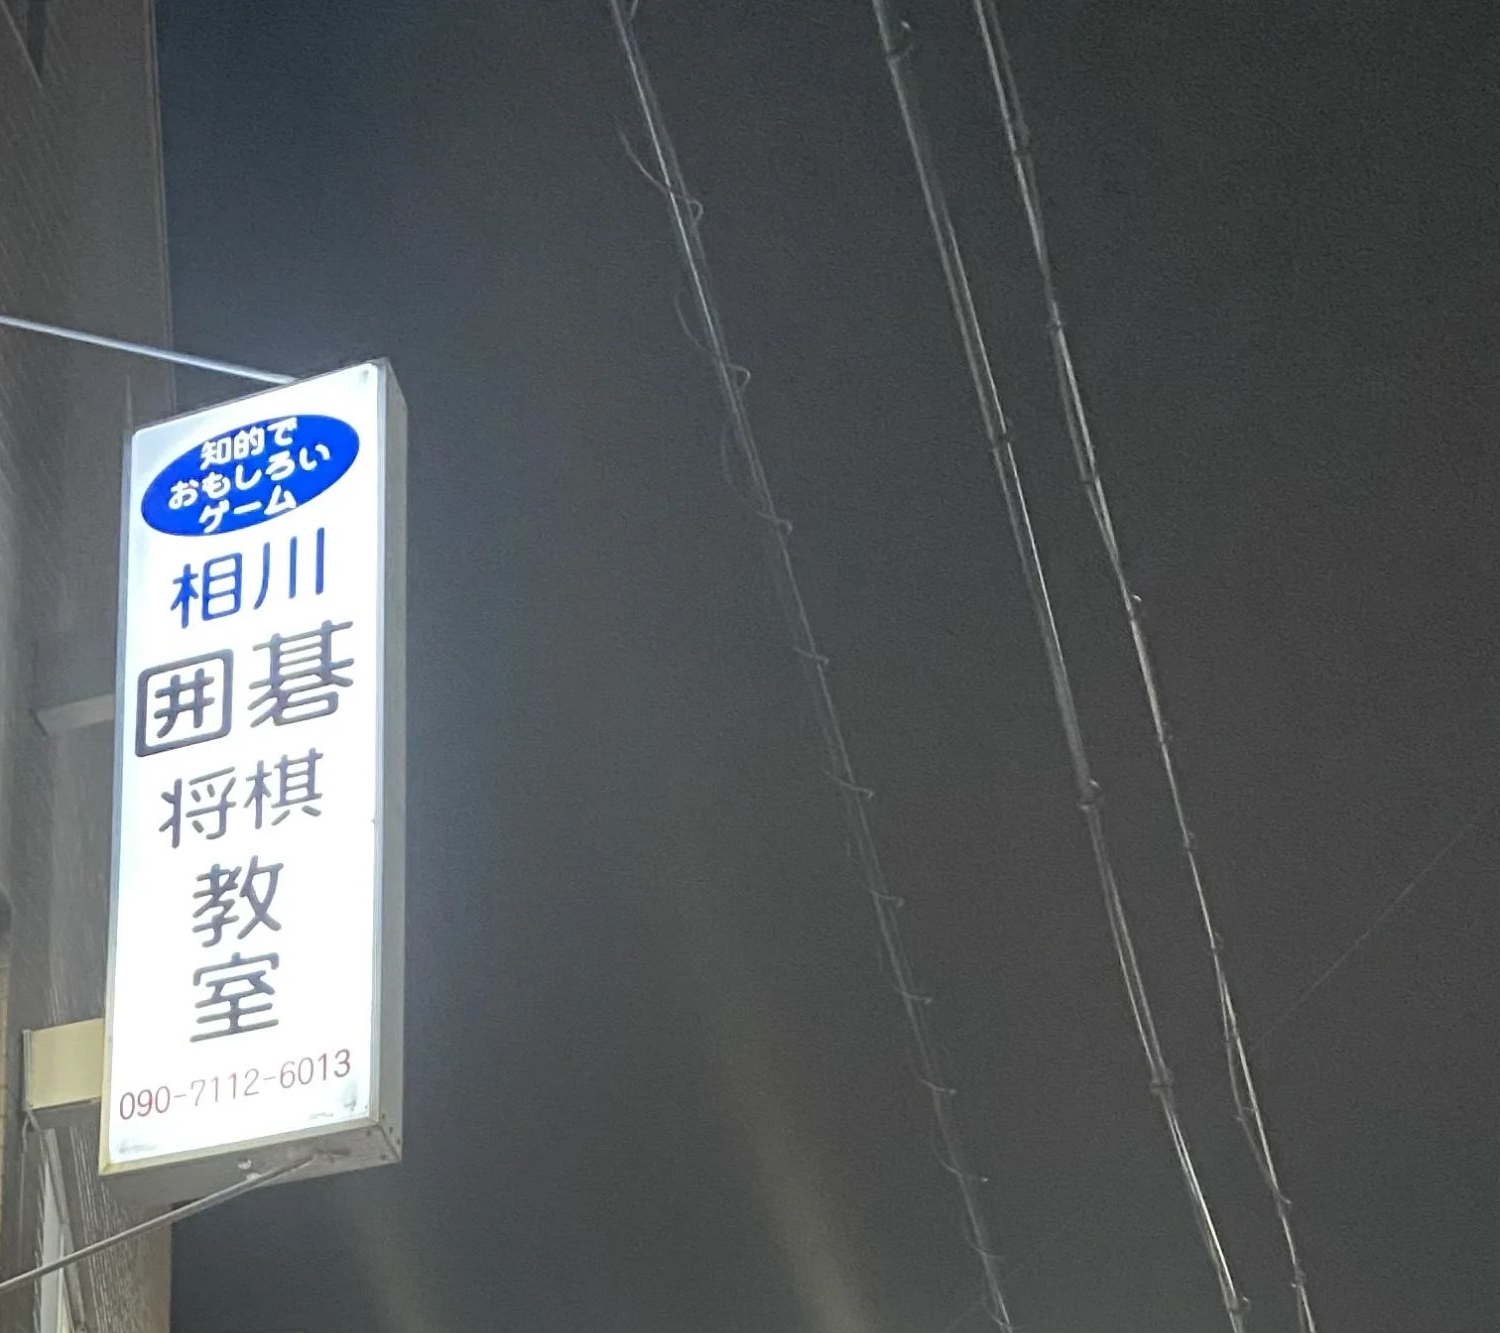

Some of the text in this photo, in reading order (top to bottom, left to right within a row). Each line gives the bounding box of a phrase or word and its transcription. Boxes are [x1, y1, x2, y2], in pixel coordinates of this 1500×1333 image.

[168, 443, 330, 509] おもしろい
[200, 418, 297, 469] 知的で
[199, 485, 297, 533] ゲーム
[170, 527, 325, 628] 相川
[135, 620, 354, 757] 囲碁
[158, 748, 324, 848] 将棋
[189, 855, 283, 1043] 教室
[118, 1048, 352, 1120] 090-7112-6013
